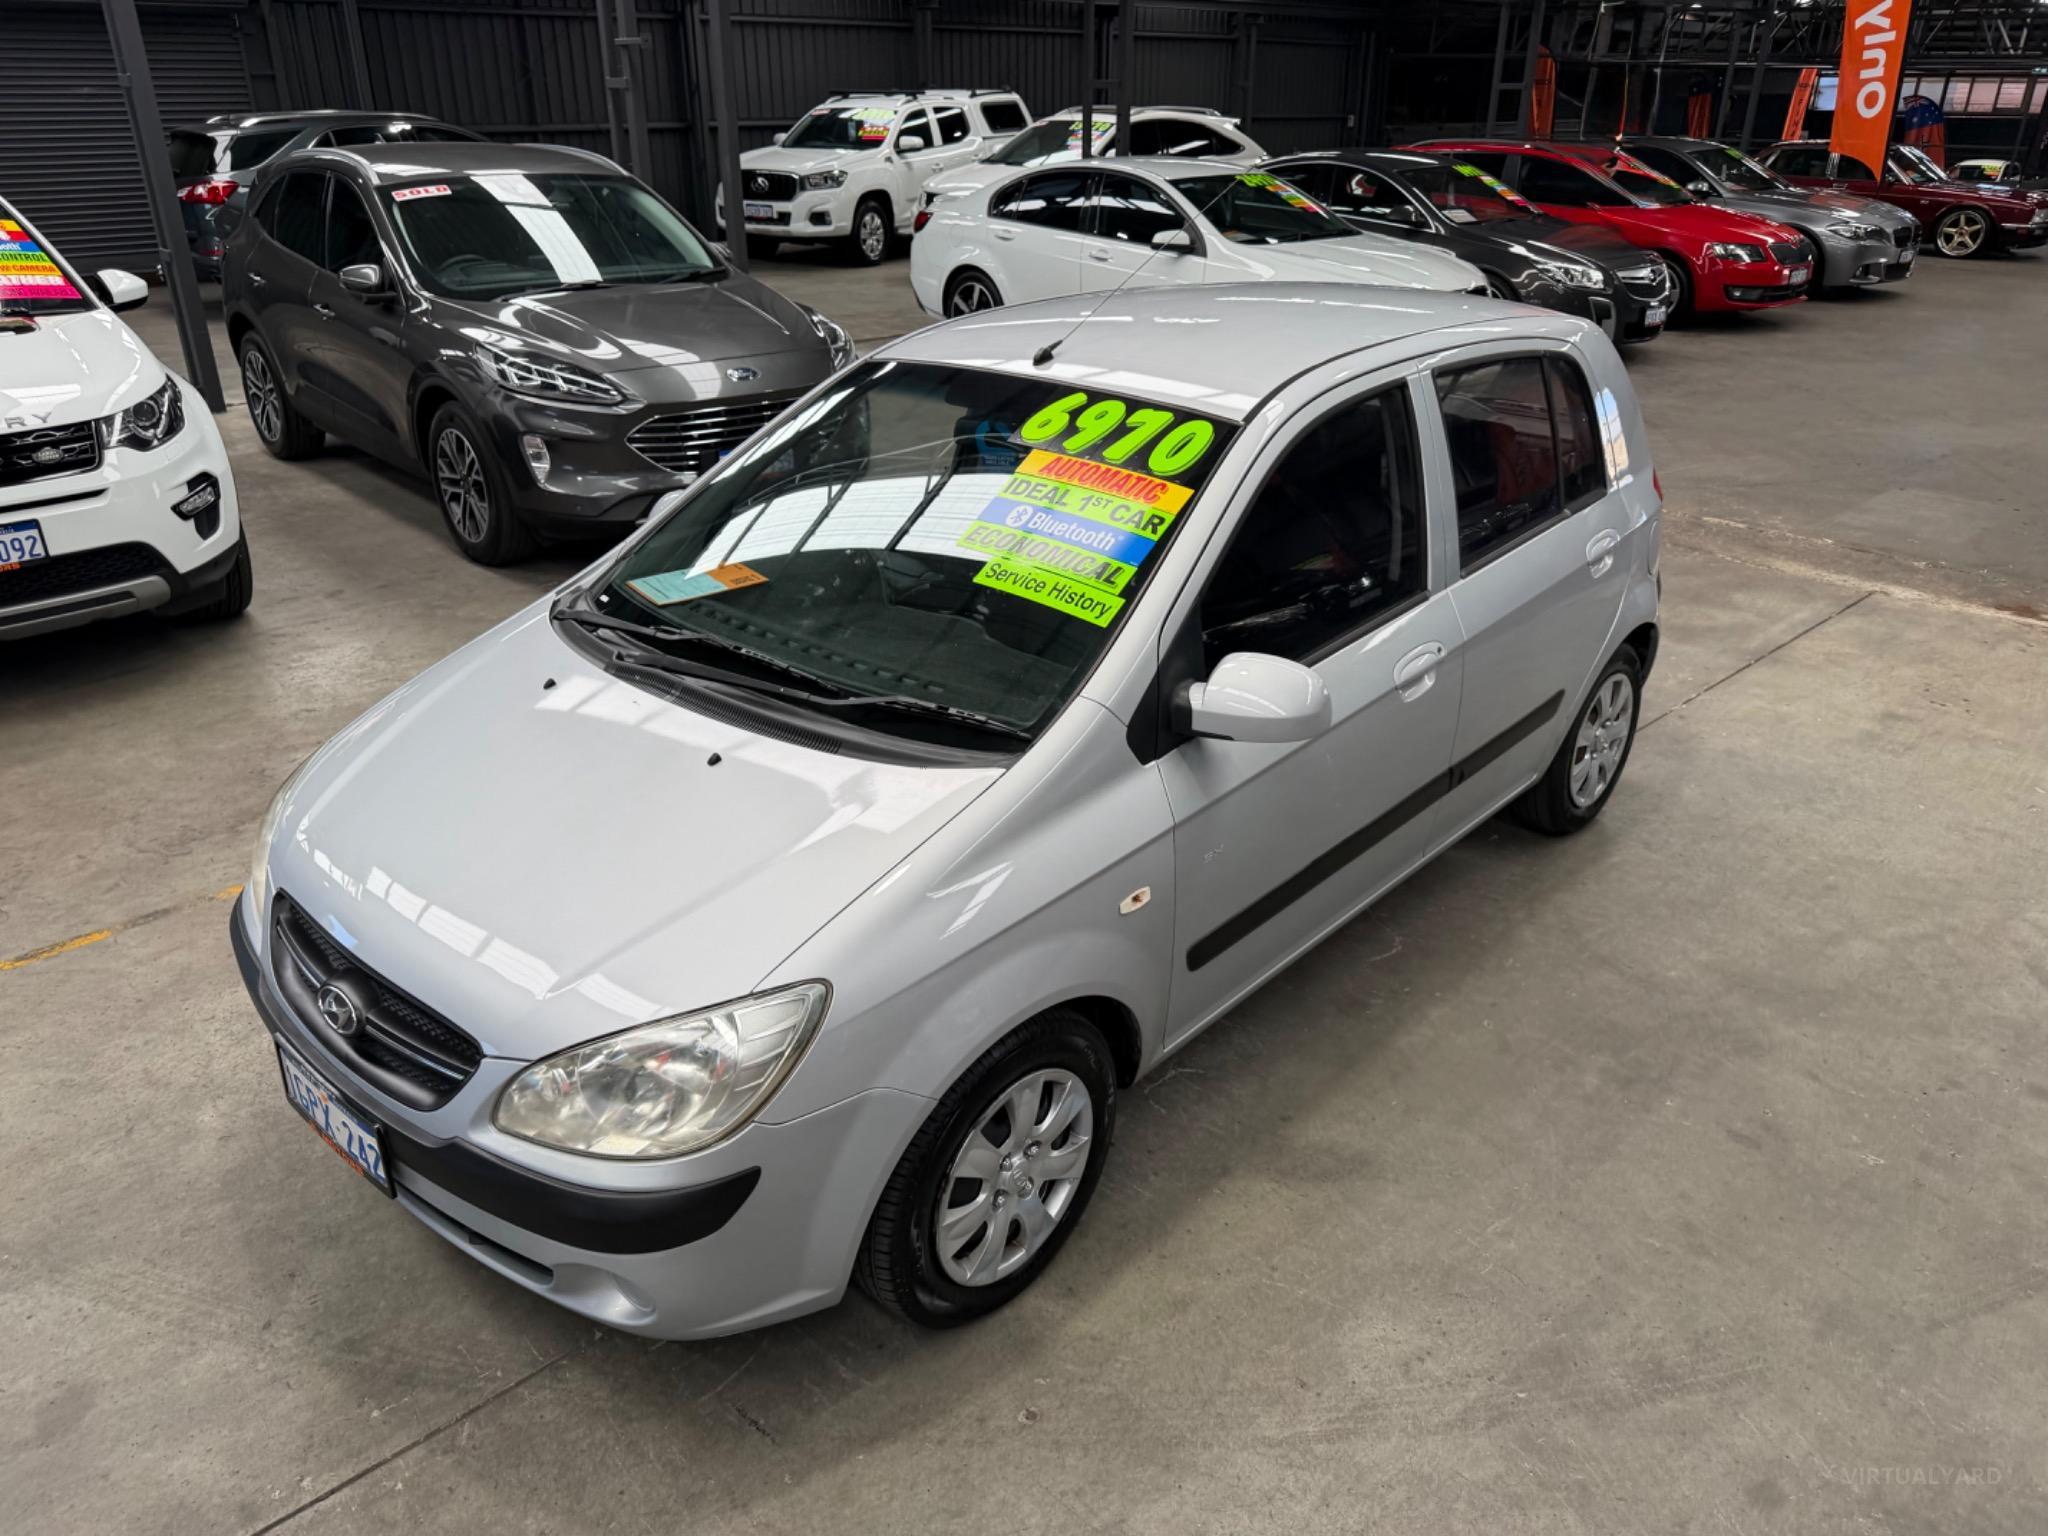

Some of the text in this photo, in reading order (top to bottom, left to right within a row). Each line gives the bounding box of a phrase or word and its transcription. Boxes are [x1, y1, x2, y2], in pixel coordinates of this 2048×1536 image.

[394, 185, 449, 199] SOLD
[0, 252, 47, 262] ONTROL
[1020, 392, 1214, 476] 6970
[1040, 456, 1168, 504] AUTOMATIC
[1003, 478, 1069, 507] IDEAL
[1108, 504, 1166, 535] CAR
[1027, 512, 1116, 551] Bluetooth
[964, 525, 1126, 587] ECONOMICAL
[984, 562, 1113, 622] Service History
